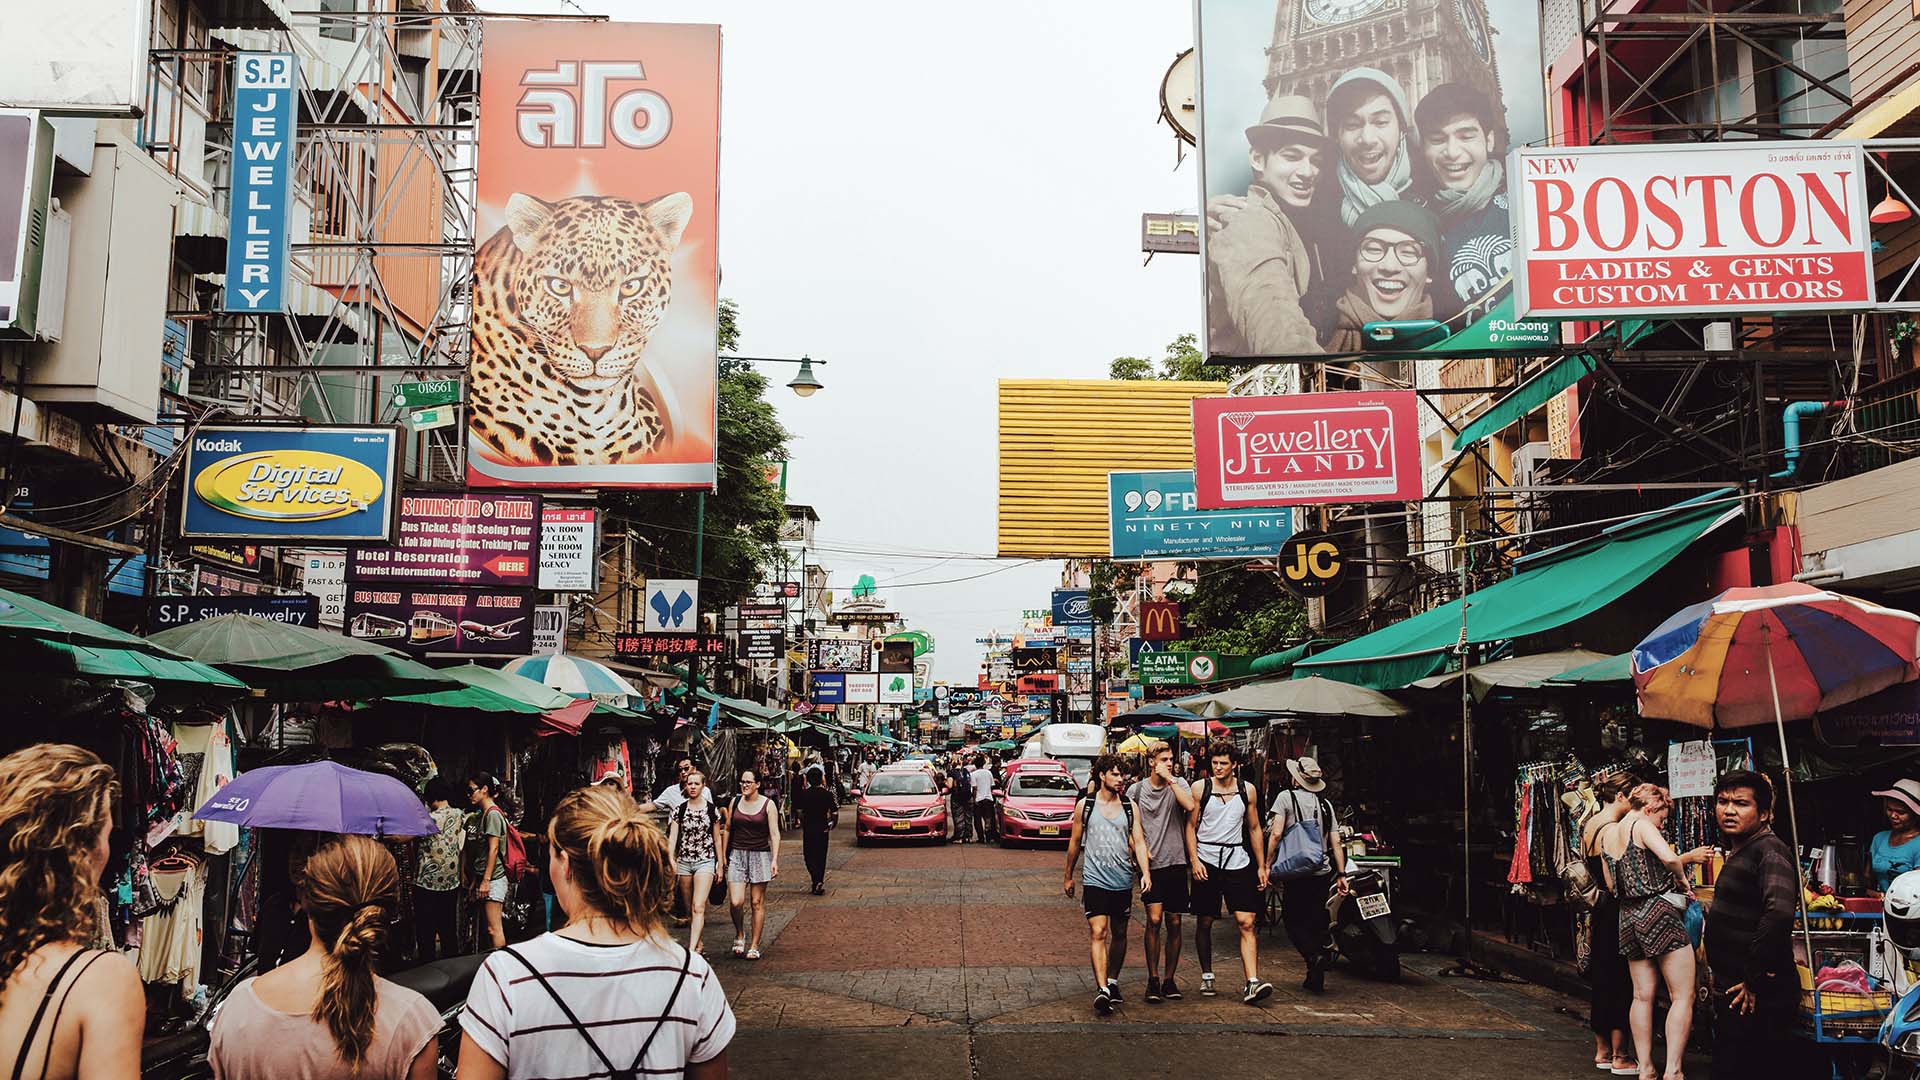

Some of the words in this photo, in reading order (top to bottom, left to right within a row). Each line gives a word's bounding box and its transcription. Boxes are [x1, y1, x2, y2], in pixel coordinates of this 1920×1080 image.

[244, 59, 287, 84] S.P.
[515, 60, 673, 149] ลีโอ
[1528, 157, 1579, 175] NEW
[239, 93, 282, 309] JEWELLERY
[1529, 170, 1853, 252] BOSTON
[1558, 260, 1671, 281] LADIES
[1688, 260, 1712, 278] &
[1729, 256, 1833, 277] GENTS
[1552, 283, 1688, 304] CUSTOM
[1702, 279, 1843, 301] TAILORS
[1489, 320, 1549, 333] #OurSong
[392, 385, 404, 395] 01
[418, 381, 452, 394] 018661
[196, 439, 242, 452] Kodak
[1253, 454, 1365, 475] LAND
[248, 462, 343, 489] Digital
[236, 482, 352, 505] Services
[413, 498, 450, 517] DIVING
[451, 499, 480, 518] TOUR
[482, 501, 494, 517] &
[495, 501, 533, 519] TRAVEL
[401, 522, 419, 532] Bus
[421, 522, 450, 534] Ticket,
[452, 523, 475, 535] Sight
[477, 524, 508, 536] Seeing
[511, 525, 531, 535] Tour
[1126, 522, 1213, 533] NINETY
[1231, 519, 1286, 530] NINE
[404, 537, 418, 547] Koh
[420, 537, 431, 547] Tao
[433, 537, 454, 549] Diving
[482, 539, 511, 551] Trekking
[513, 541, 530, 550] Tour
[1163, 537, 1200, 545] Manufacturer
[1216, 535, 1246, 543] Wholesaler
[357, 551, 389, 561] Hotel
[394, 551, 469, 564] Reservation
[1285, 542, 1341, 580] JC
[355, 566, 389, 575] Tourist
[391, 566, 447, 577] Information
[450, 568, 482, 578] Center
[498, 562, 524, 572] HERE
[354, 591, 371, 604] BUS
[373, 592, 401, 605] TICKET
[412, 594, 437, 606] TRAIN
[439, 595, 467, 607] TICKET
[476, 595, 492, 607] AIR
[494, 596, 521, 608] TICKET
[160, 605, 193, 622] S.P.
[326, 605, 339, 614] 20
[1155, 656, 1177, 664] ATM
